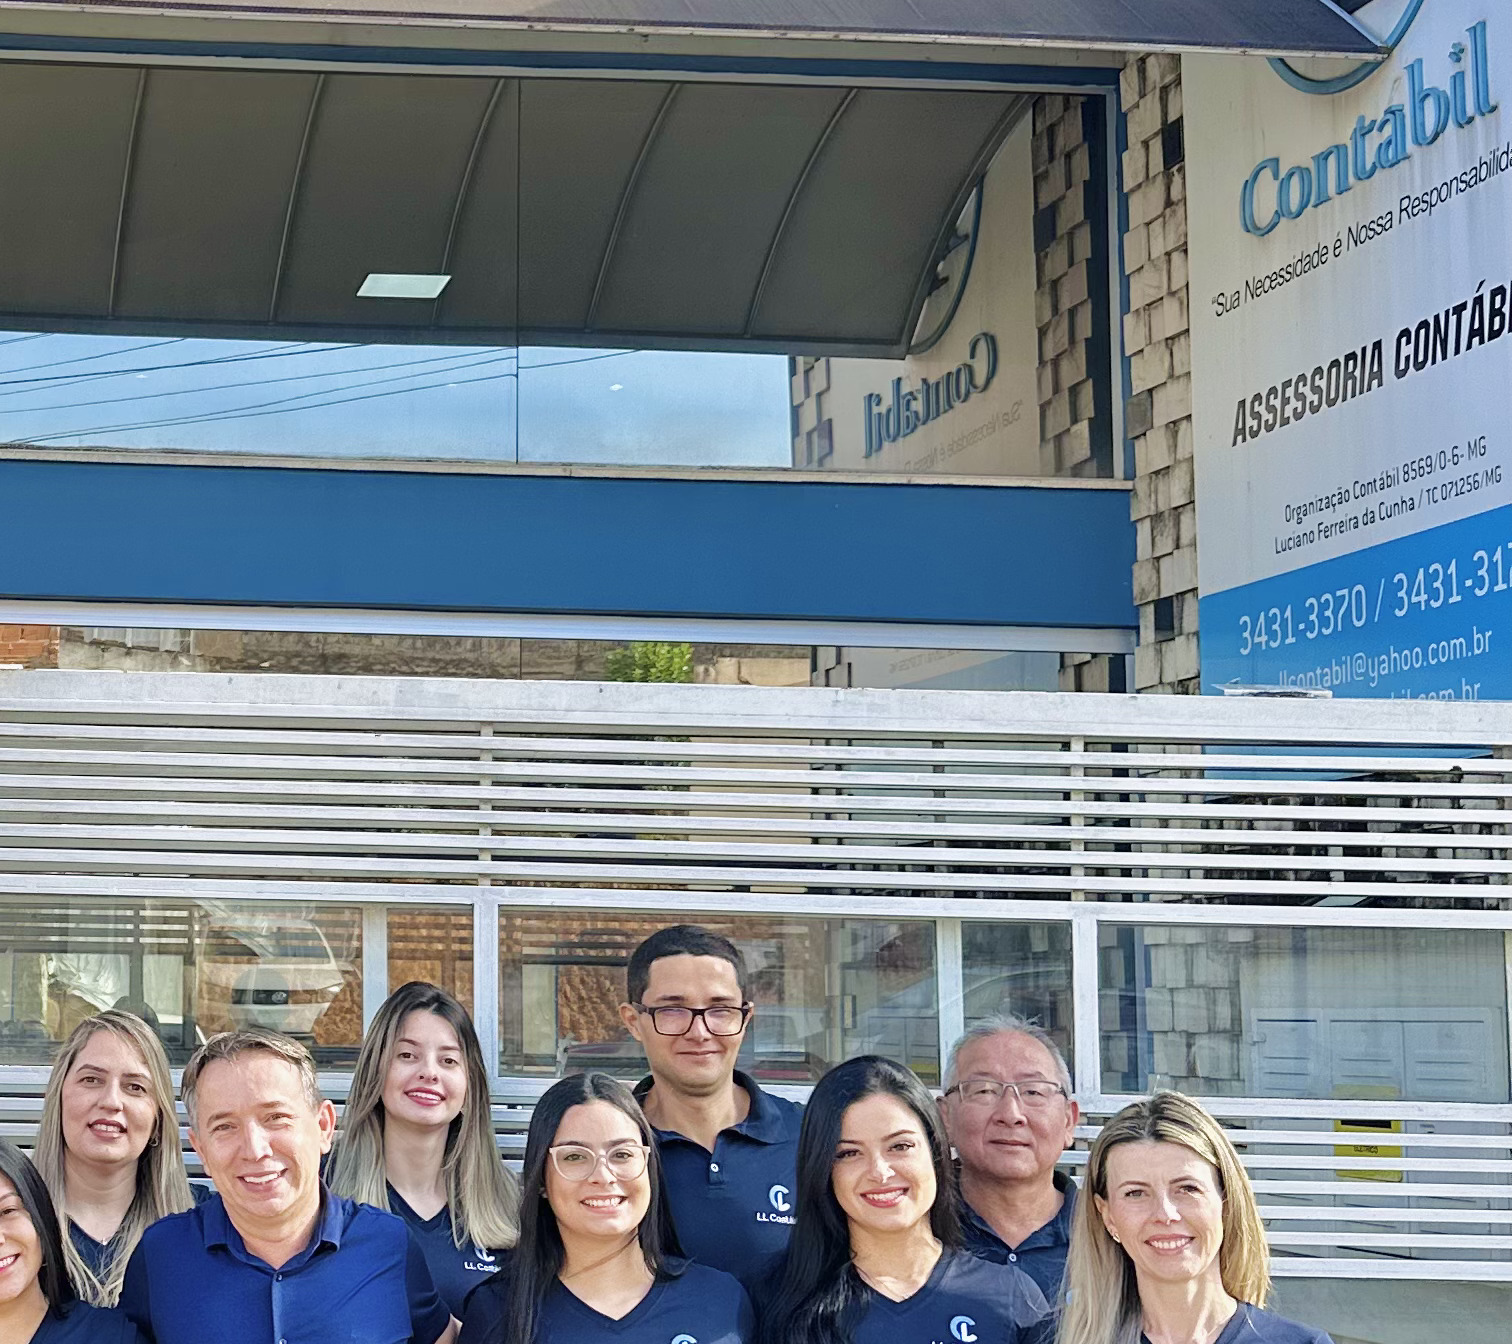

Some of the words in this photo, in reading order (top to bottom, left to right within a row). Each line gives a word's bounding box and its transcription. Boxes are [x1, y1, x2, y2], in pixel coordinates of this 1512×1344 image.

[1244, 241, 1329, 304] Necessidade
[1333, 231, 1342, 257] é
[1347, 210, 1393, 252] Nossa
[1399, 140, 1512, 225] Responsabilid
[1232, 338, 1383, 447] ASSESSORIA
[1274, 530, 1315, 555] Luciano
[1317, 513, 1359, 541] Ferreira
[1362, 506, 1376, 526] da
[1378, 496, 1415, 521] Cunha
[1417, 488, 1424, 509] /
[1426, 486, 1439, 506] TC
[1440, 465, 1502, 501] 071256/MG
[1284, 485, 1351, 525] Organização
[1353, 466, 1400, 500] Contábil
[1468, 435, 1487, 461] MG
[1239, 584, 1367, 656] 3431-3370
[1374, 577, 1386, 623] /
[1279, 625, 1493, 689] llcontabil@yahoo.com.br
[756, 1212, 769, 1222] LL
